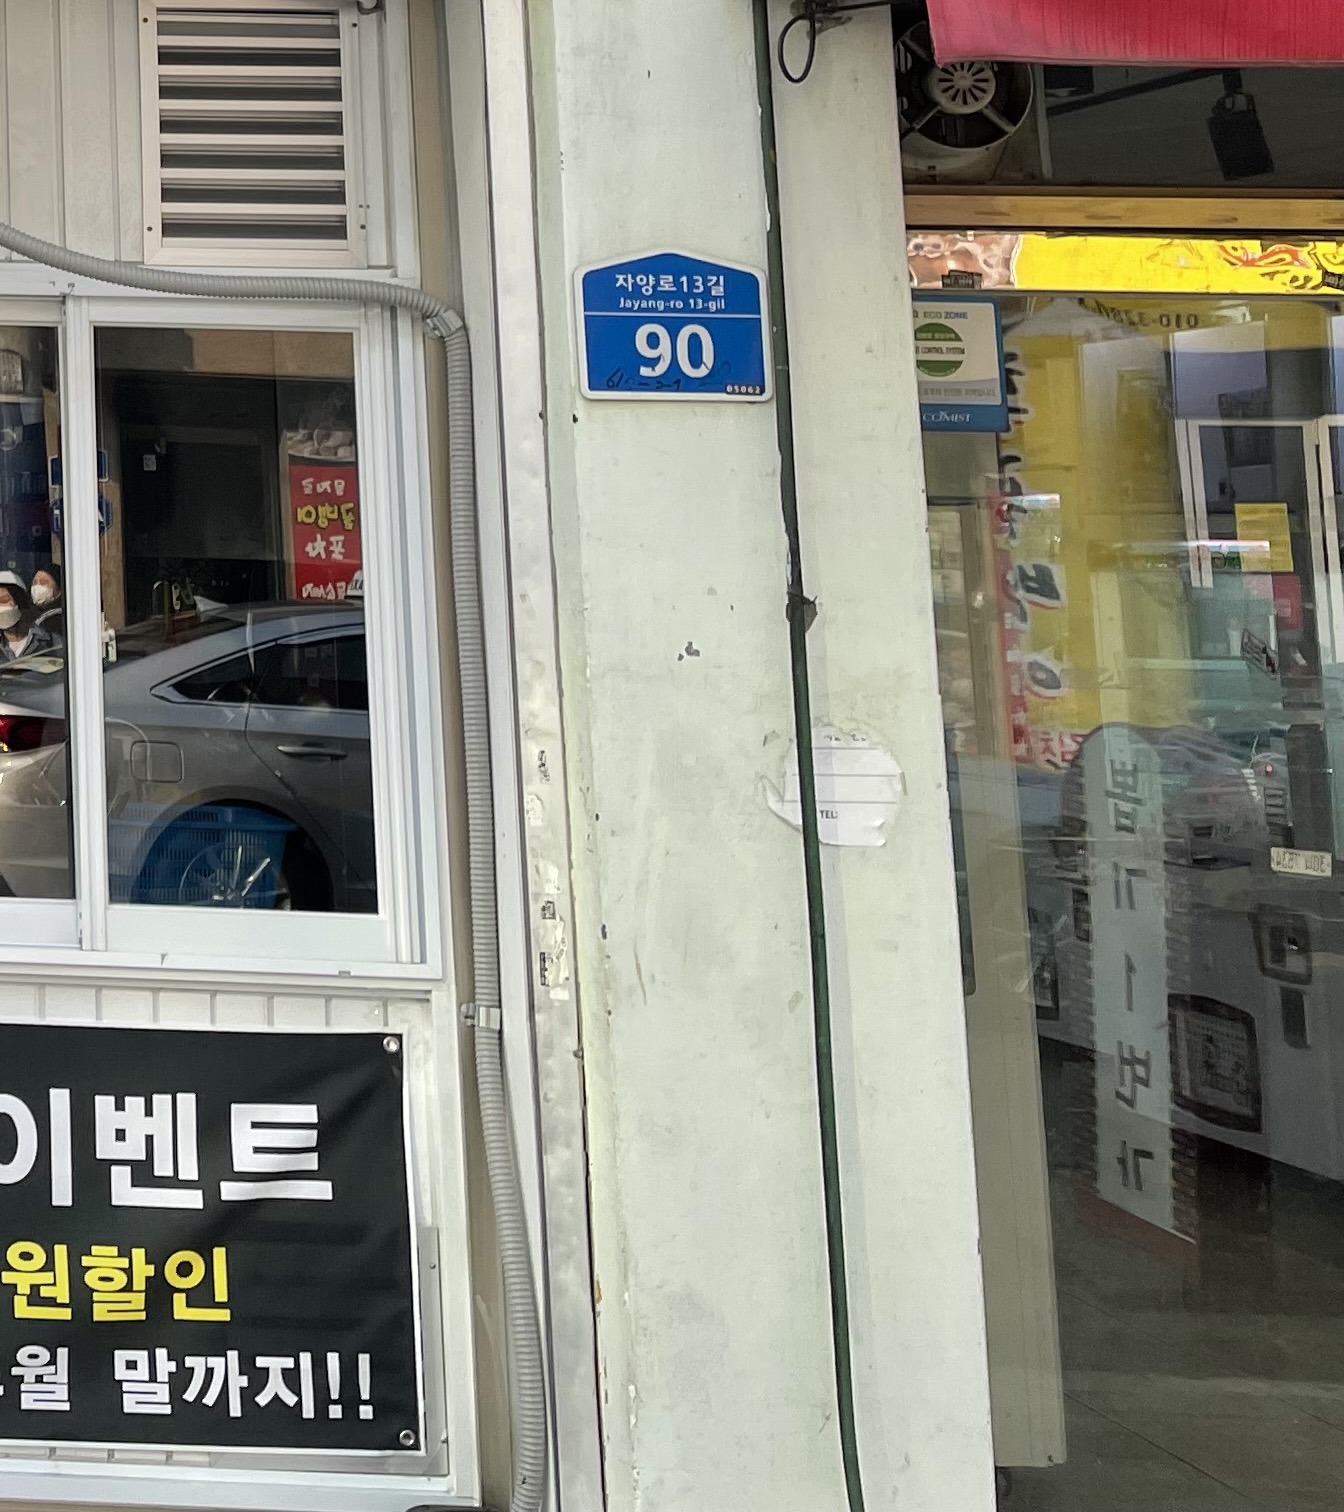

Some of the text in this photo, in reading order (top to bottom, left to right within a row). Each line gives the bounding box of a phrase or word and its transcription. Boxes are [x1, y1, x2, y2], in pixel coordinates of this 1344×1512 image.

[615, 272, 725, 297] 자양로13길
[618, 296, 726, 312] Jayang-ro 13-gil
[634, 322, 715, 379] 90
[726, 384, 762, 395] 05062
[114, 1349, 377, 1422] 말까지!!
